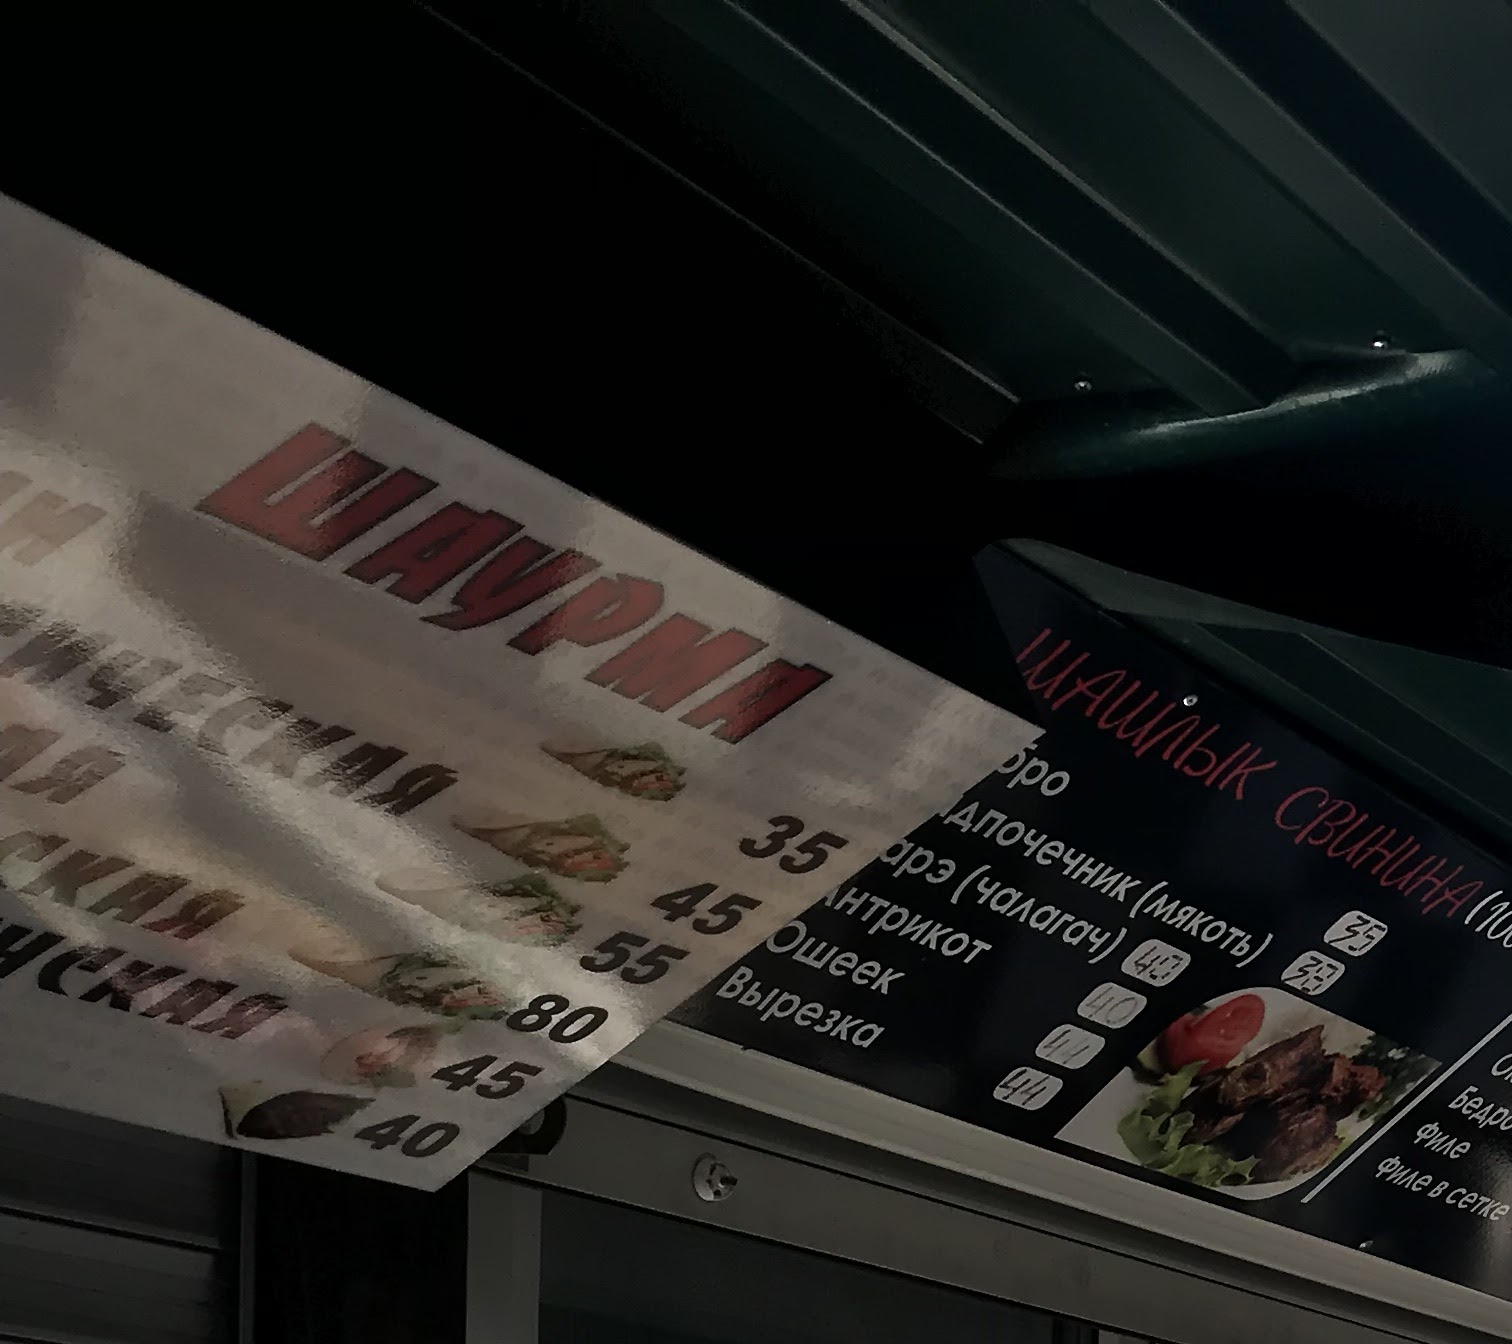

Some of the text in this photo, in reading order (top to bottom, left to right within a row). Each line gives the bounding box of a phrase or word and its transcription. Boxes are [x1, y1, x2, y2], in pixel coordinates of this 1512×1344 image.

[194, 423, 834, 745] ШАУРМА
[1015, 626, 1279, 801] ШАШЛЫК
[1272, 785, 1485, 919] СВИНИНА
[739, 815, 849, 874] 35
[650, 882, 762, 935] 45
[940, 801, 1143, 903] дпочечник
[1128, 880, 1274, 969] (мякоть)
[950, 864, 1128, 964] (чалагач)
[1133, 941, 1183, 980] 40
[1331, 914, 1386, 954] 35
[580, 930, 691, 985] 55
[763, 919, 906, 996] Ошеек
[496, 993, 608, 1044] 80
[1085, 988, 1142, 1024] 40
[715, 965, 1049, 1107] Вырезка 44
[430, 1054, 544, 1100] 45
[354, 1114, 461, 1159] 40
[1428, 1183, 1445, 1199] в
[1444, 1186, 1511, 1221] сетке
